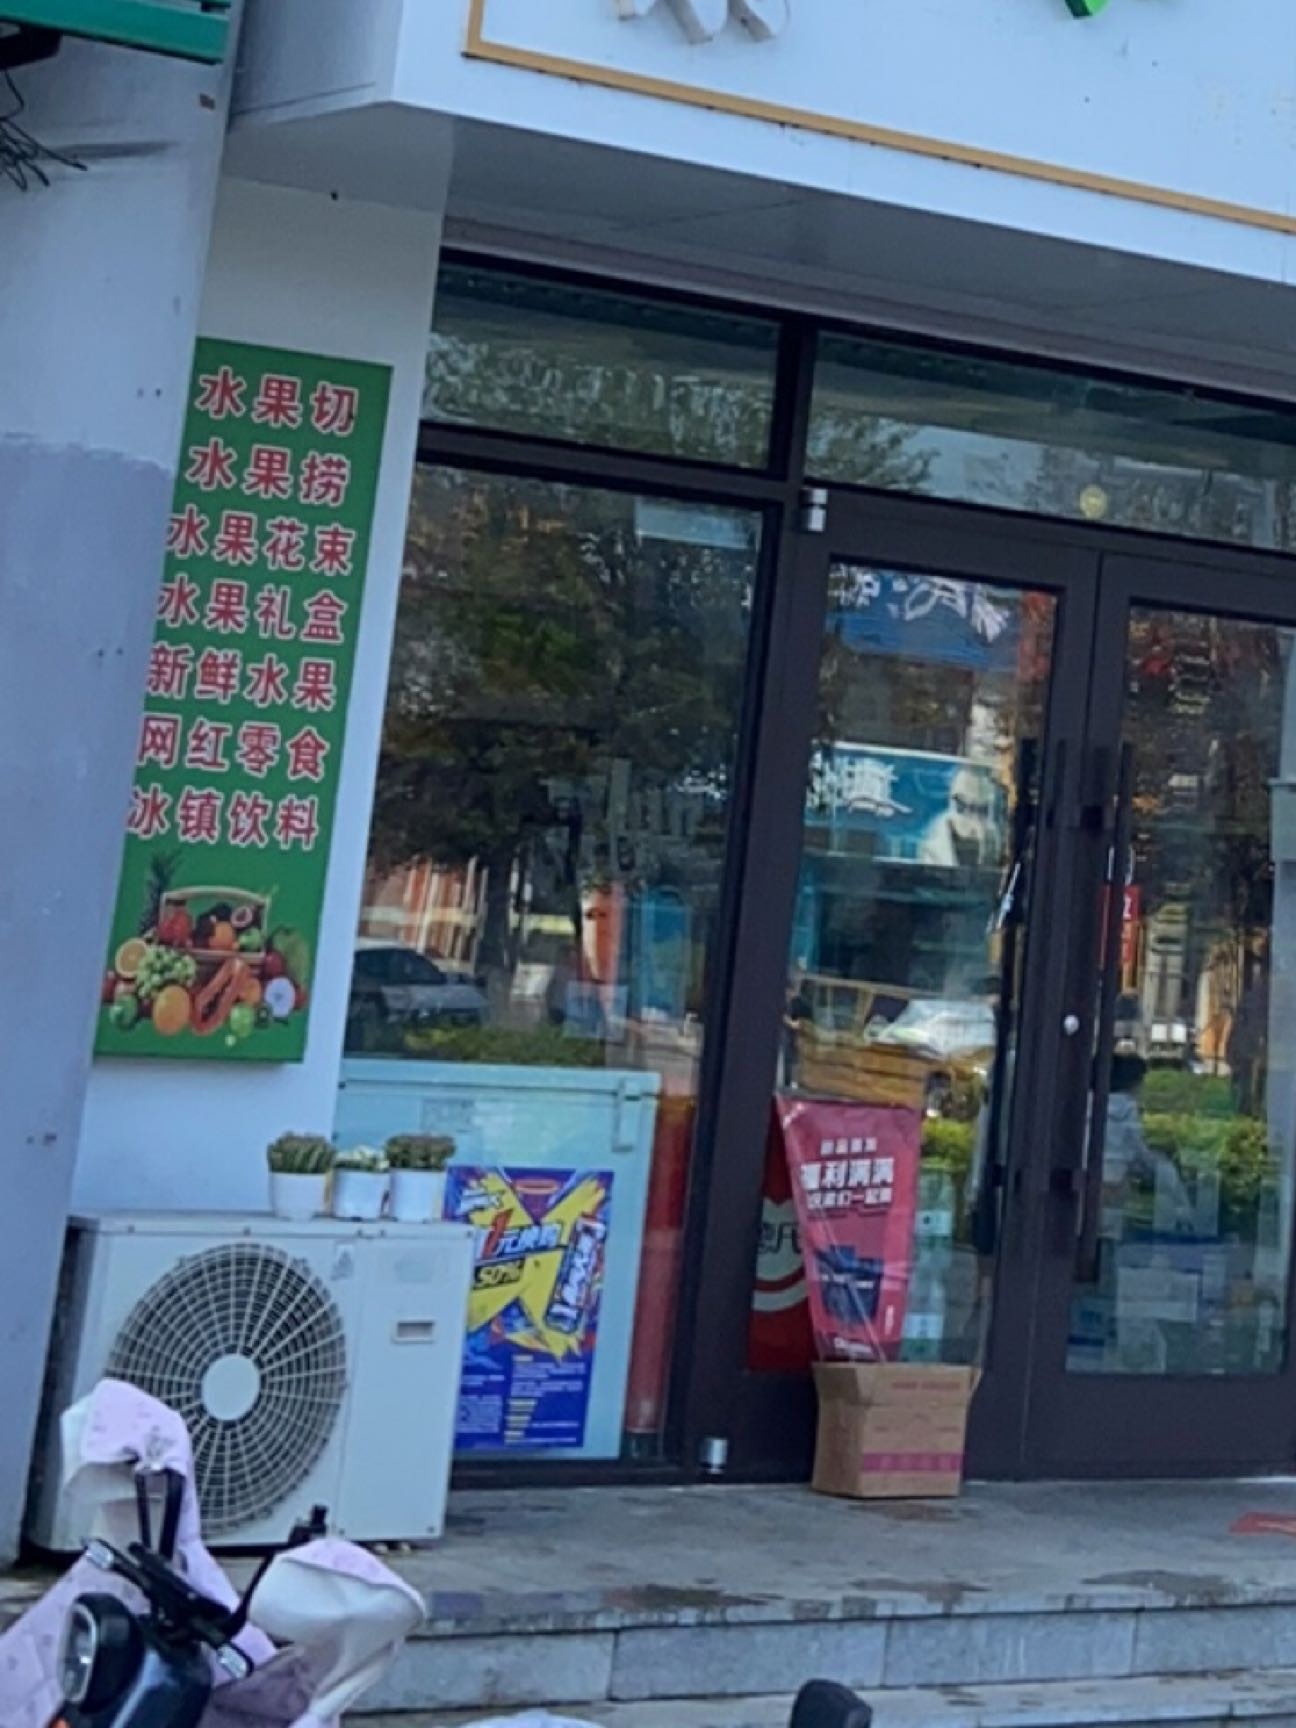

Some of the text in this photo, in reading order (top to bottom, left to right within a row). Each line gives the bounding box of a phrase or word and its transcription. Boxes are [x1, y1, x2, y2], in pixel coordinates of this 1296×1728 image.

[195, 365, 359, 436] 水果切
[185, 436, 351, 505] 水果捞
[166, 503, 356, 577] 水果花束
[156, 570, 346, 644] 水果礼盒
[145, 640, 338, 713] 新鲜水果
[137, 712, 331, 782] 网红零食
[126, 783, 320, 852] 冰镇饮料
